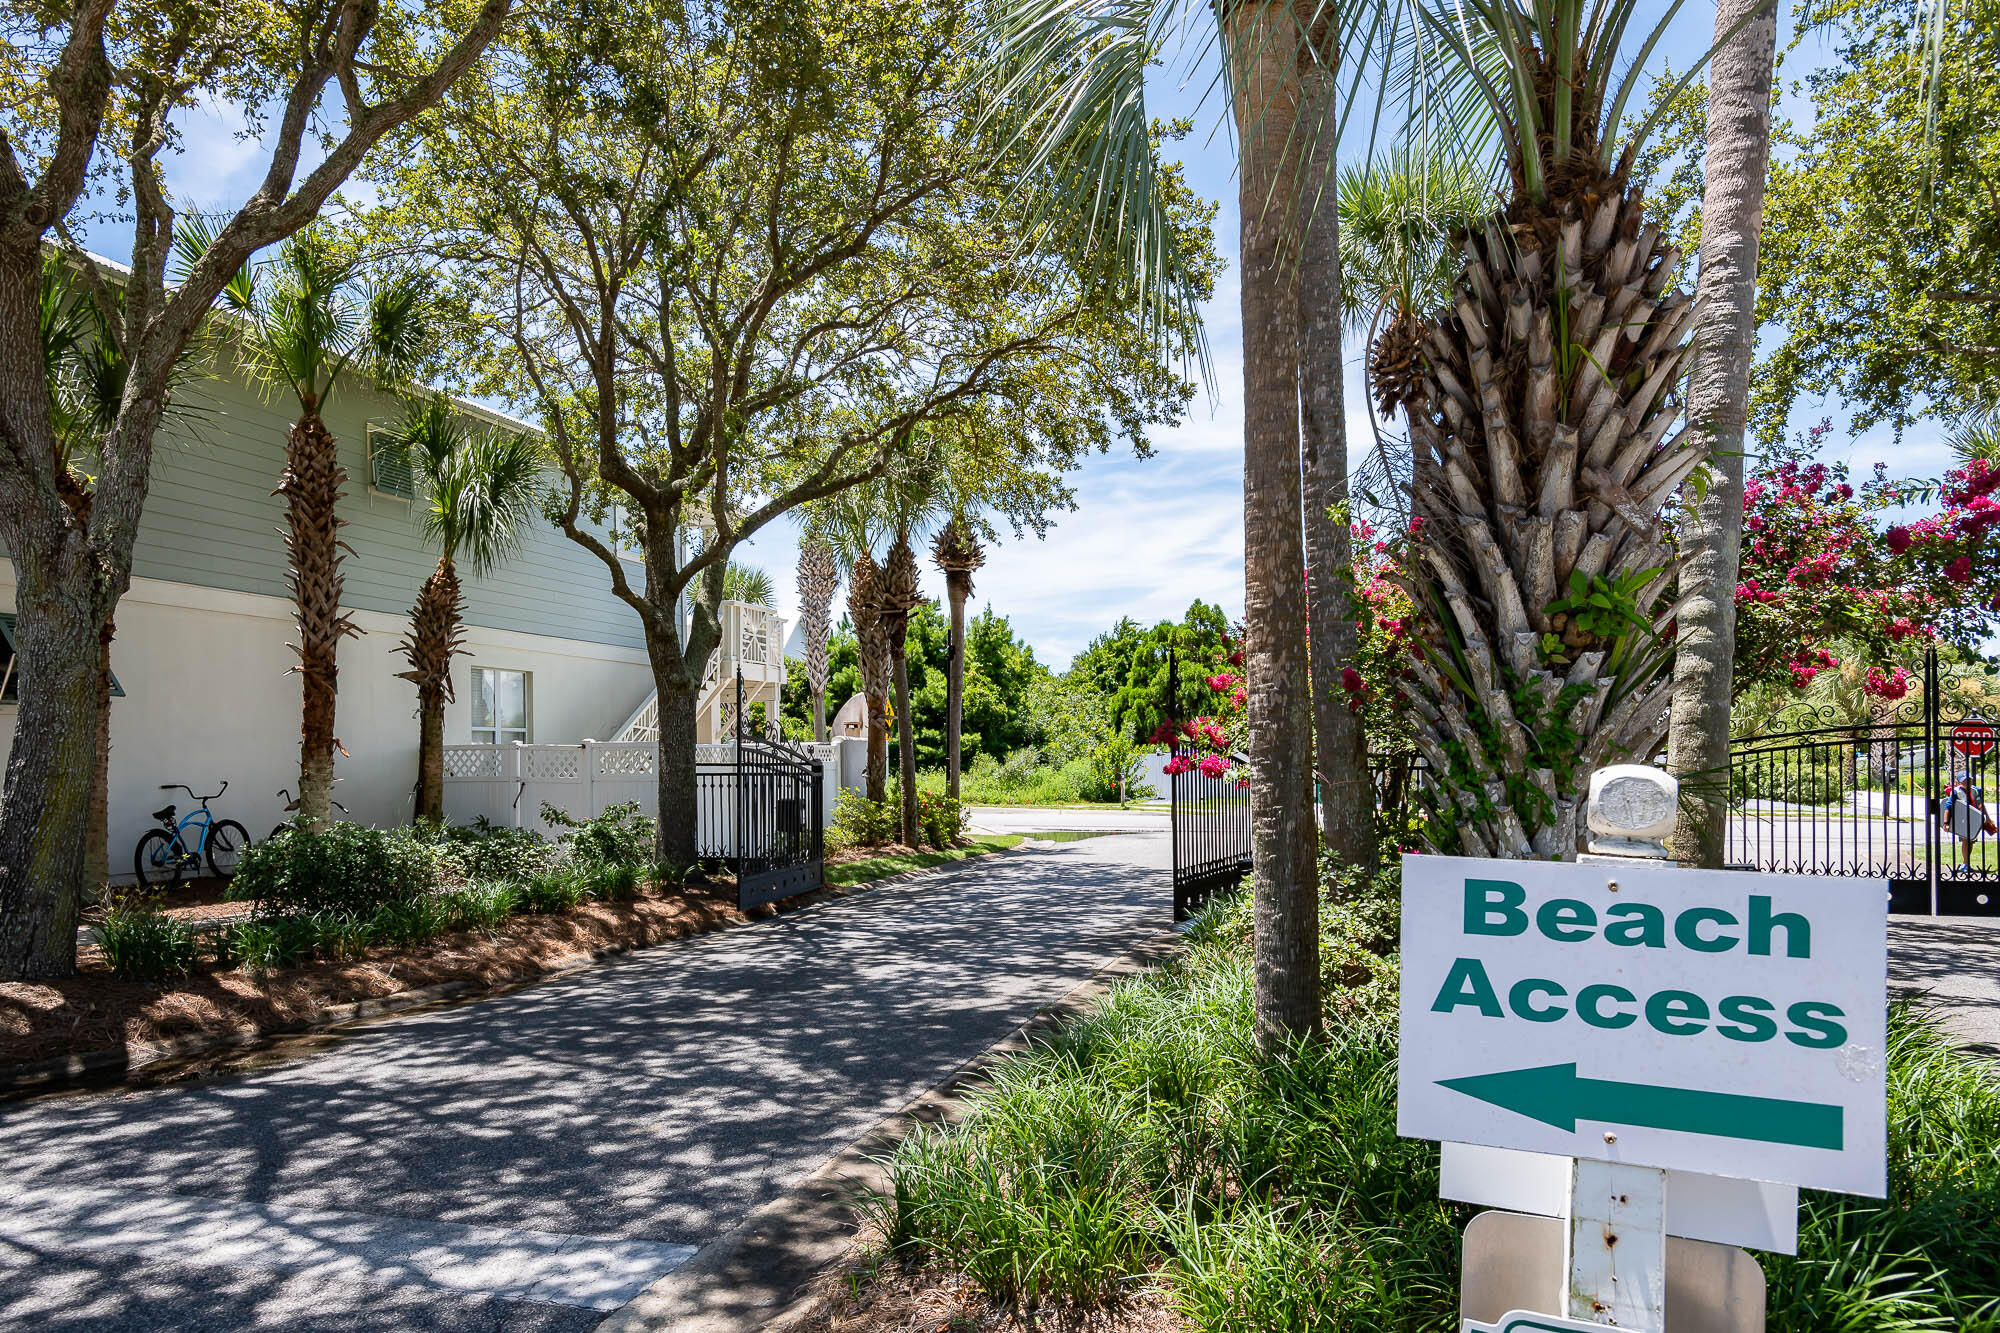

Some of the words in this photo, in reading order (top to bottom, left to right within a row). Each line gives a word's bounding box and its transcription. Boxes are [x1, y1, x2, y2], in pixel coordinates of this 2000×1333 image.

[1955, 731, 1991, 745] STOP
[1463, 879, 1811, 959] Beach
[1431, 957, 1848, 1049] Access
